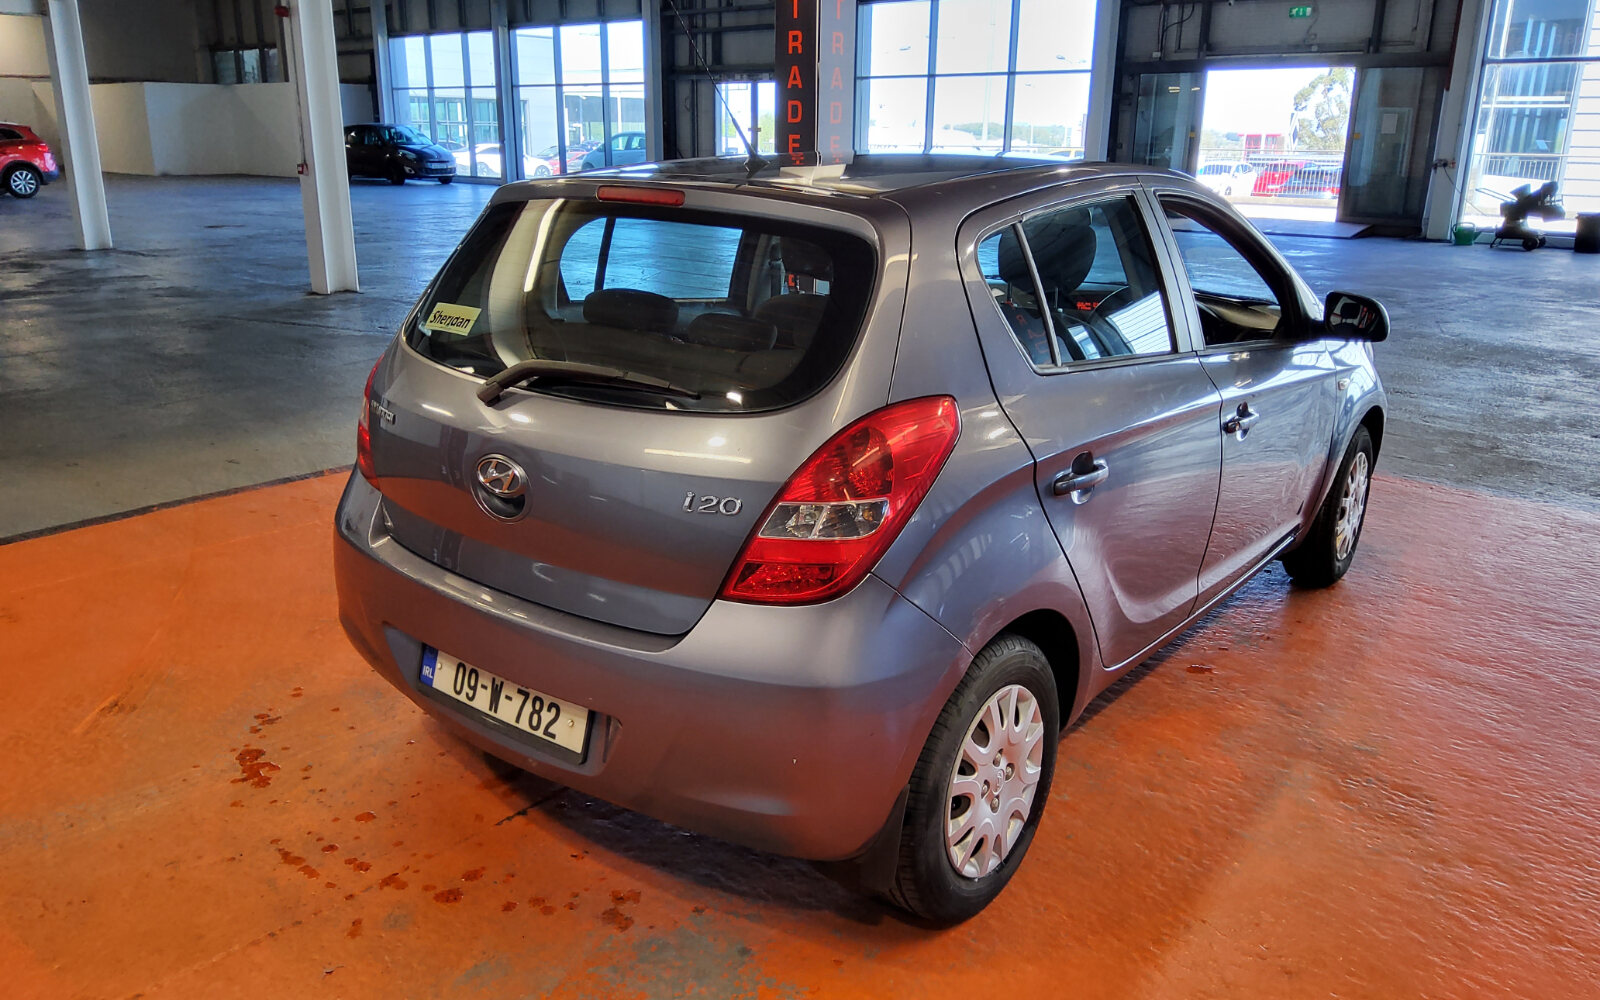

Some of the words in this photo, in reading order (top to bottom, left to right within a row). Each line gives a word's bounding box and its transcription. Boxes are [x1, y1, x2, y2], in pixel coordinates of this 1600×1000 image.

[430, 310, 471, 329] Sheridan
[683, 491, 742, 515] i20
[423, 665, 434, 679] IRL
[453, 661, 561, 740] 09-W-782
